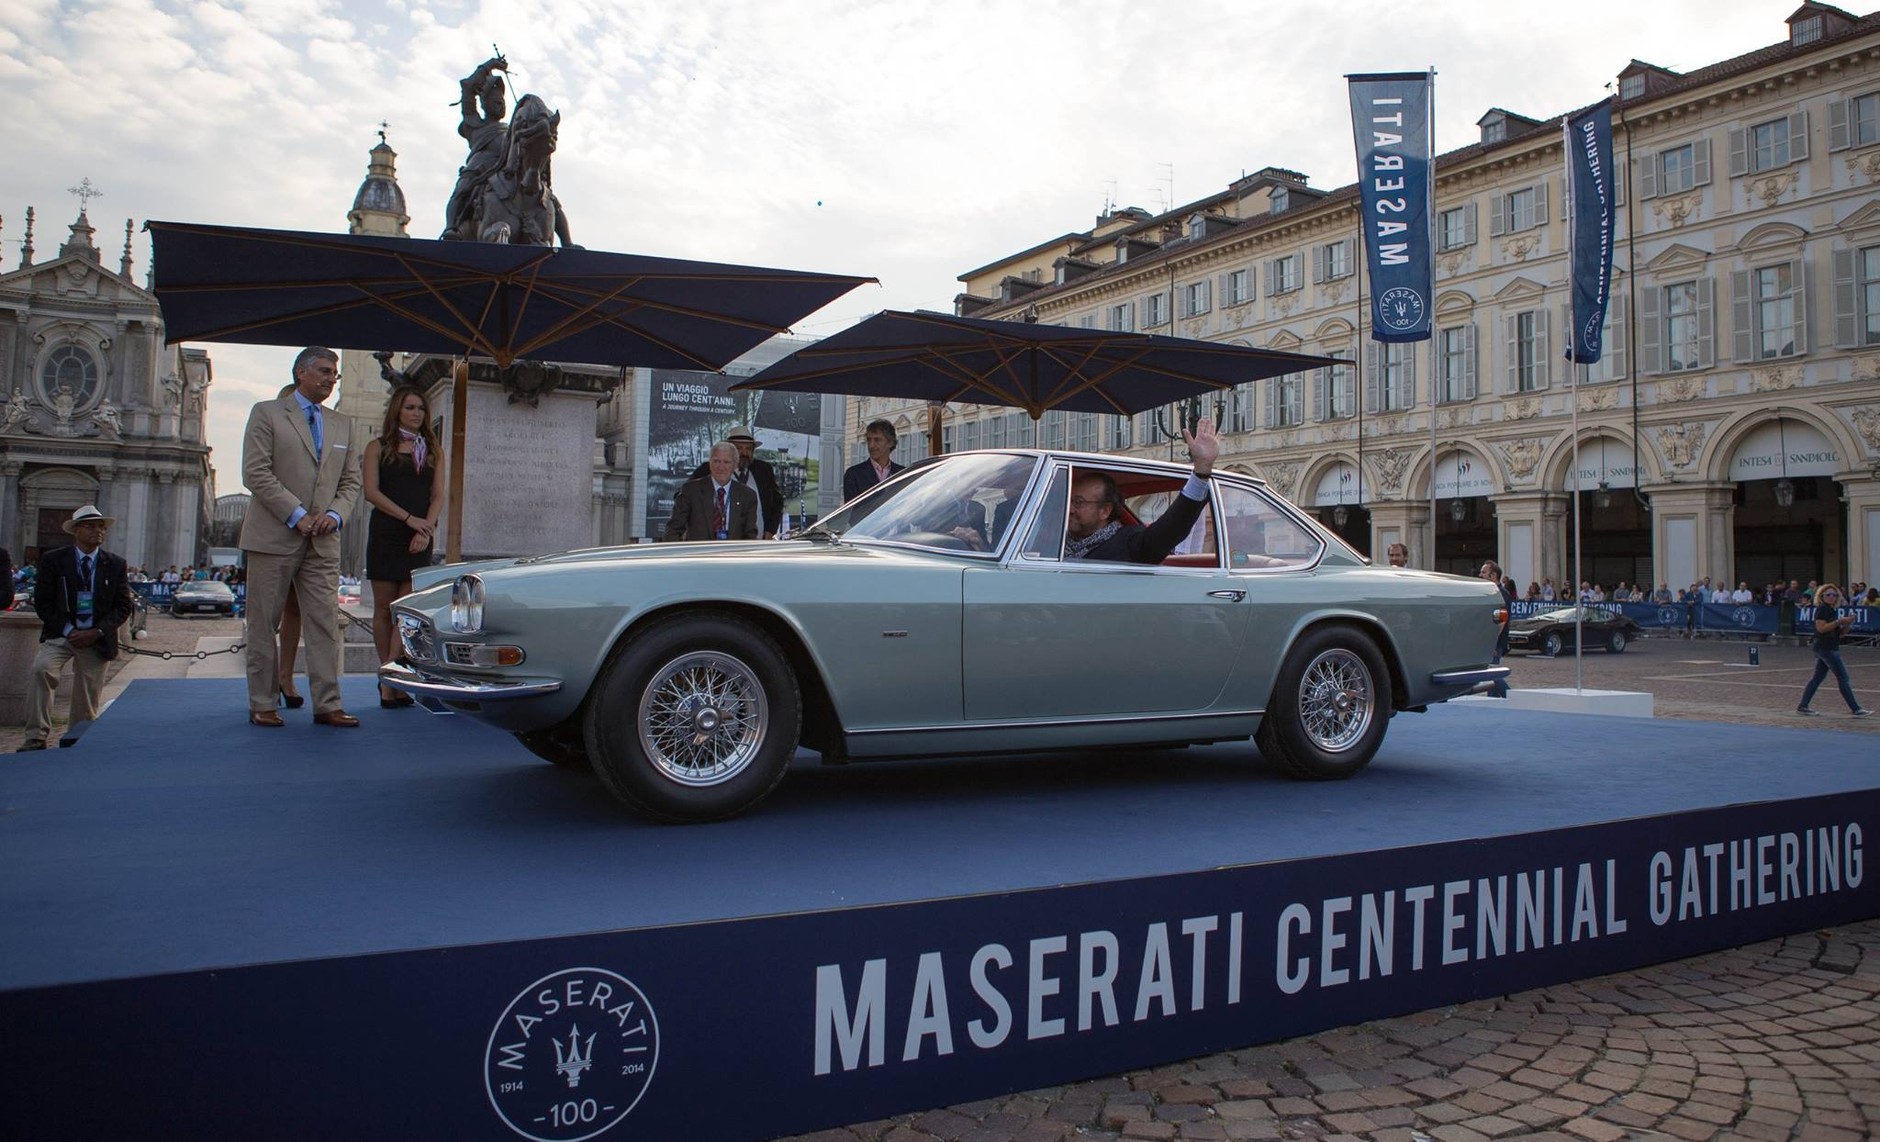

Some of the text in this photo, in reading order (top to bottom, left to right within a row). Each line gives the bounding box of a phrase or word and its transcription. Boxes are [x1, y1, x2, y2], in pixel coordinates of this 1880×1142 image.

[662, 382, 709, 395] UN VIAGGIO
[662, 392, 736, 407] LUNGO CENT'ANNI.
[1739, 456, 1772, 468] INTESA
[1570, 469, 1597, 479] ITESA
[812, 822, 1864, 1076] MASERATI CENTENNIAL GATHERING
[497, 980, 648, 1070] MASERATI
[621, 1063, 645, 1075] 2014
[500, 1081, 524, 1094] 1914
